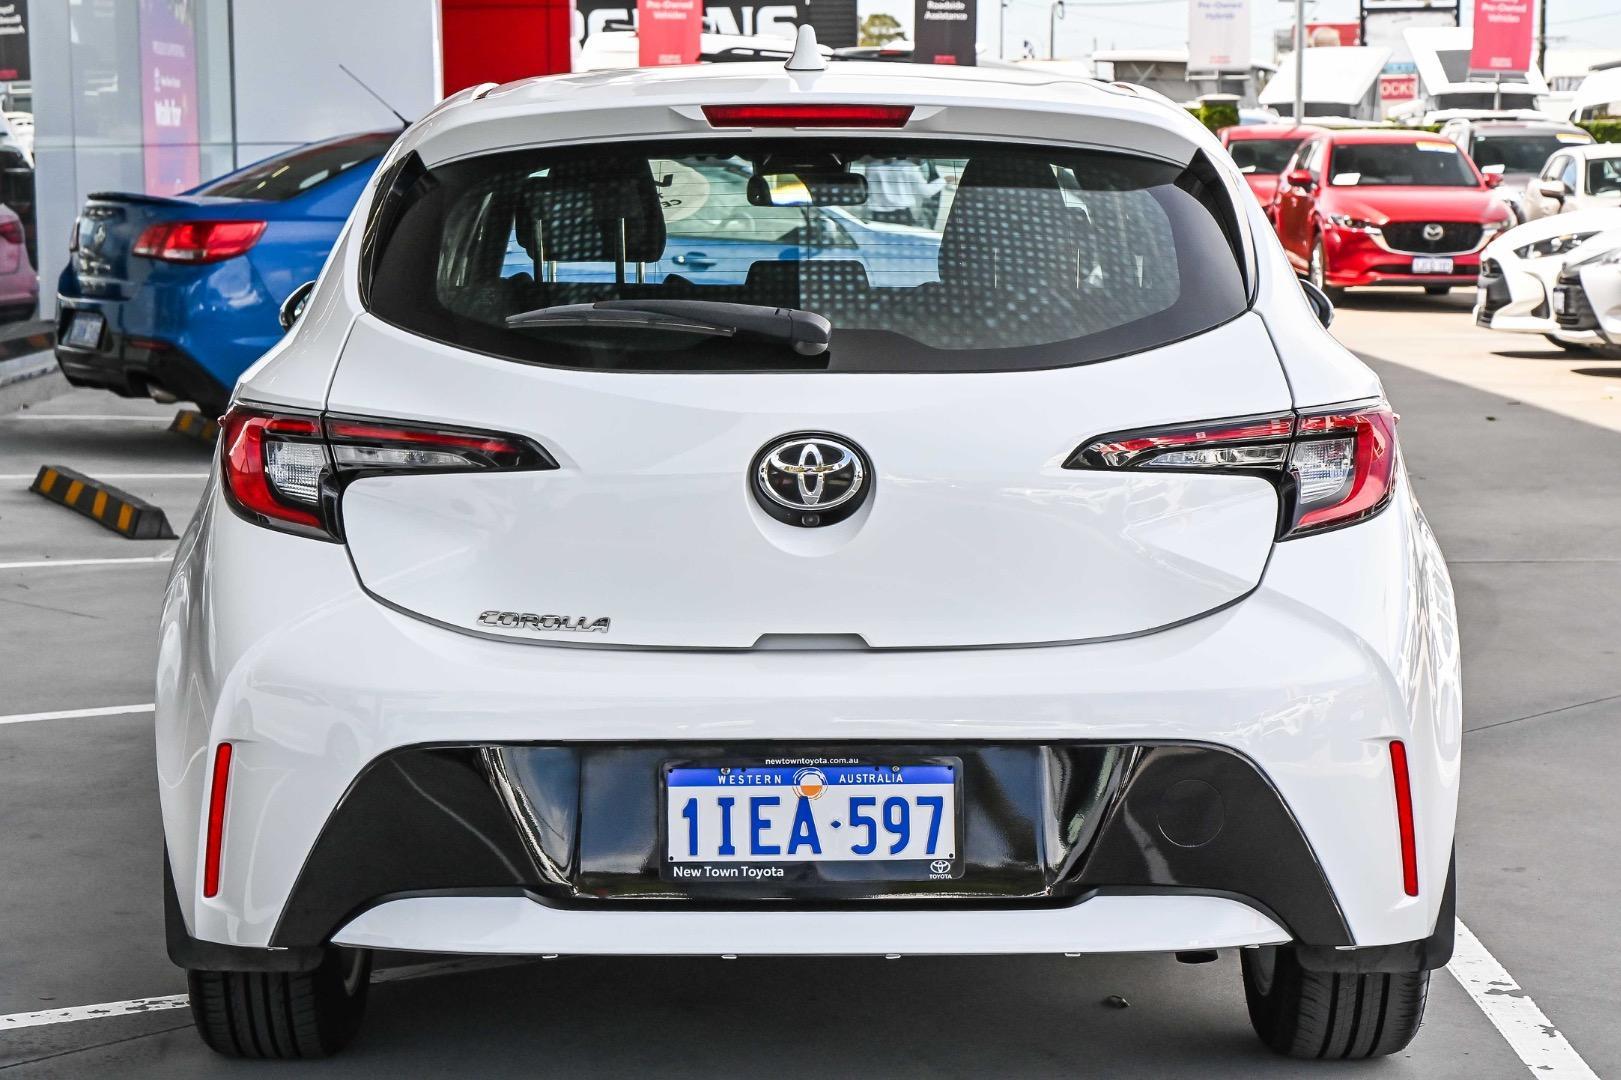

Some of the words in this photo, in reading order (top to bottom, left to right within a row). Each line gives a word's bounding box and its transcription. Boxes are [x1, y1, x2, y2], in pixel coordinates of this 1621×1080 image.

[926, 1, 966, 10] Roadside
[924, 10, 968, 20] Assistance
[477, 610, 611, 633] COROLLA
[765, 757, 859, 766] newtowntoyota.com.au
[718, 775, 782, 785] WESTERN
[839, 773, 904, 784] AUSTRALIA
[673, 866, 702, 877] New
[704, 866, 739, 877] Town
[741, 866, 785, 879] Toyota
